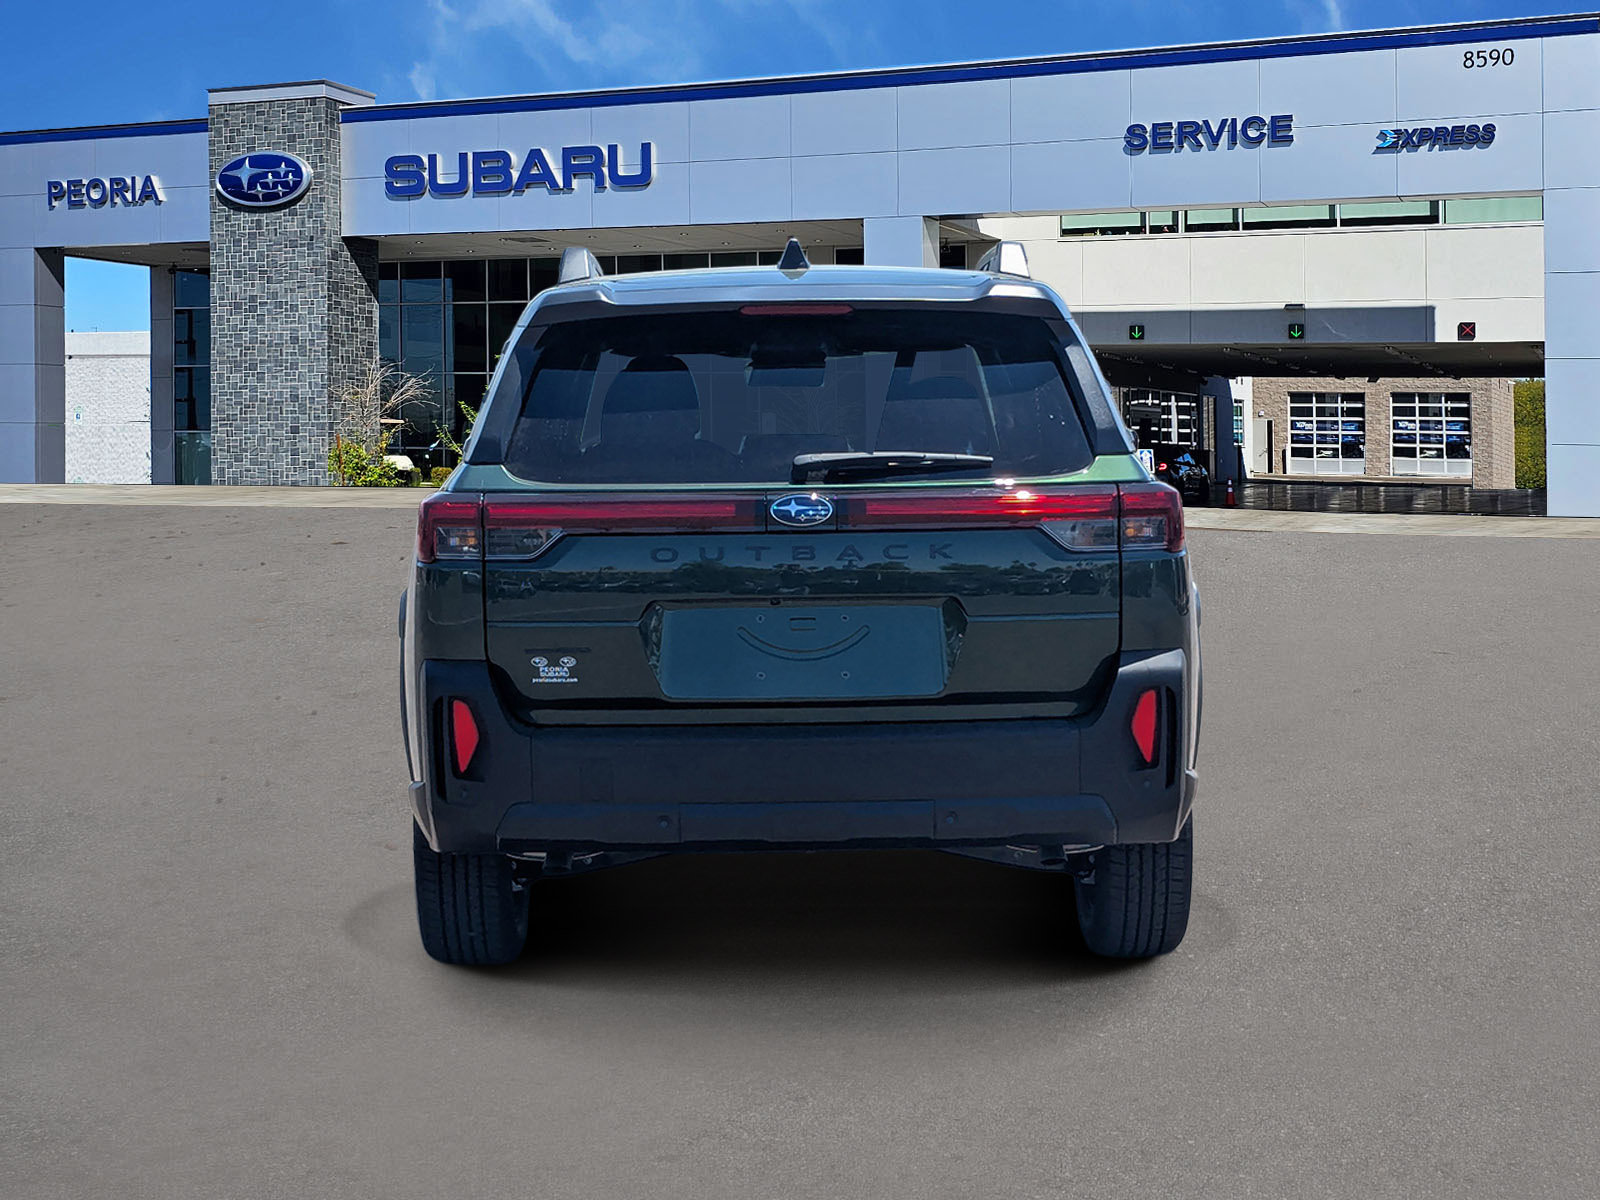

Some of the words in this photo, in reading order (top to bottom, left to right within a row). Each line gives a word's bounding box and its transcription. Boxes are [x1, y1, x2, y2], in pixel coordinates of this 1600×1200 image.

[1463, 47, 1515, 69] 8590
[1124, 114, 1294, 152] SERVICE
[1376, 122, 1496, 150] EXPRESS
[384, 141, 652, 197] SUBARU
[48, 174, 162, 208] PEORIA
[650, 543, 953, 563] OUTBACK
